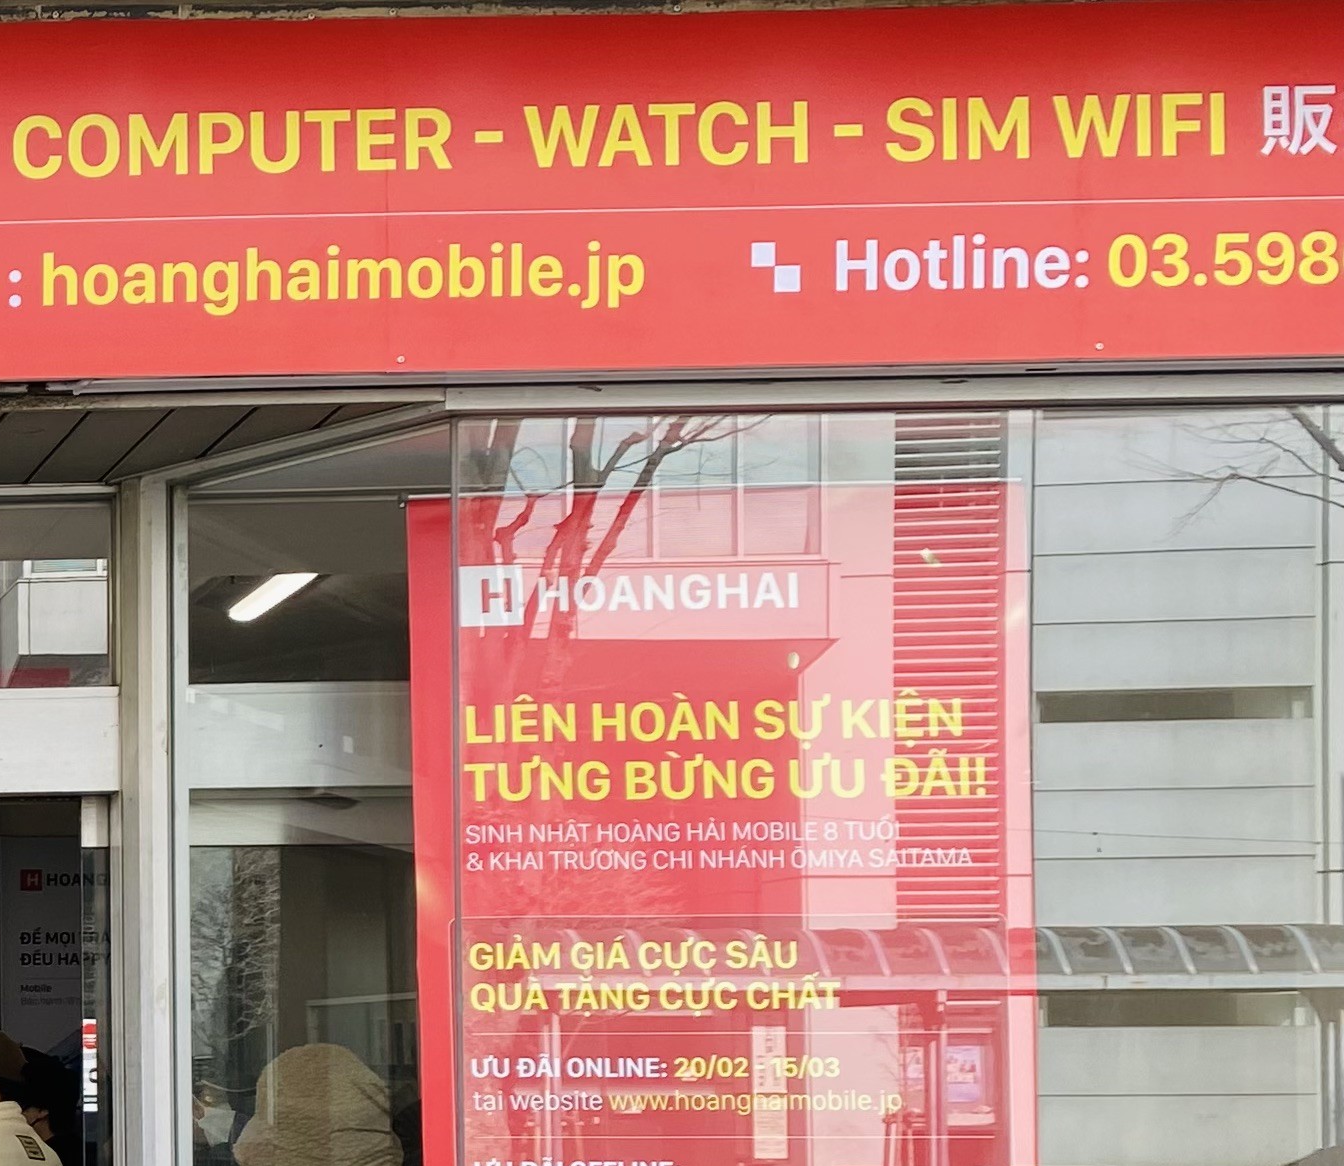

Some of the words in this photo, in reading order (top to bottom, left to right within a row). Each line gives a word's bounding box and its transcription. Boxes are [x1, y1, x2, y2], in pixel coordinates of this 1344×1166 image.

[11, 107, 453, 180] COMPUTER
[474, 129, 504, 145] -
[524, 100, 809, 168] WATCH
[833, 123, 864, 138] -
[885, 96, 1031, 163] SIM
[1052, 92, 1227, 159] WIFI
[1261, 84, 1337, 156] 販
[42, 241, 646, 316] hoanghaimobile.jp
[835, 234, 1089, 292] Hotline:
[1108, 230, 1344, 289] 03.598
[538, 570, 800, 614] HOANGHAI
[464, 693, 577, 745] LIÊN
[592, 691, 740, 743] HOÀN
[754, 693, 831, 748] SỰ
[844, 686, 965, 749] KIỆN
[625, 749, 776, 801] BỪNG
[788, 756, 867, 800] ƯU
[881, 747, 988, 800] ĐÃI!
[465, 822, 523, 845] SINH
[528, 818, 592, 848] NHẬT
[596, 815, 681, 844] HOÀNG
[686, 815, 729, 843] HẢI
[732, 820, 824, 843] MOBILE
[823, 820, 838, 841] 8
[845, 815, 902, 843] TUỔI
[466, 850, 485, 872] &
[488, 849, 544, 871] KHAI
[548, 848, 647, 871] TRƯƠNG
[652, 848, 693, 870] CHI
[698, 844, 786, 870] NHÁNH
[790, 846, 865, 870] ŌMIYA
[868, 846, 975, 869] SAITAMA
[45, 931, 76, 947] MỌI
[468, 934, 562, 972] GIẢM
[570, 935, 629, 971] GIÁ
[638, 936, 717, 974] CỰC
[725, 934, 799, 970] SÂU
[469, 976, 550, 1013] QUÀ
[558, 976, 651, 1018] TẶNG
[659, 979, 739, 1016] CỰC
[746, 971, 842, 1010] CHẤT
[471, 1056, 510, 1079] ƯU
[517, 1052, 561, 1079] ĐÃI
[567, 1057, 668, 1079] ONLINE:
[674, 1056, 750, 1081] 20/02
[769, 1056, 841, 1080] 15/03
[473, 1092, 504, 1114] tại
[510, 1090, 603, 1112] website
[609, 1088, 903, 1115] www.hoanghaimobile.jp
